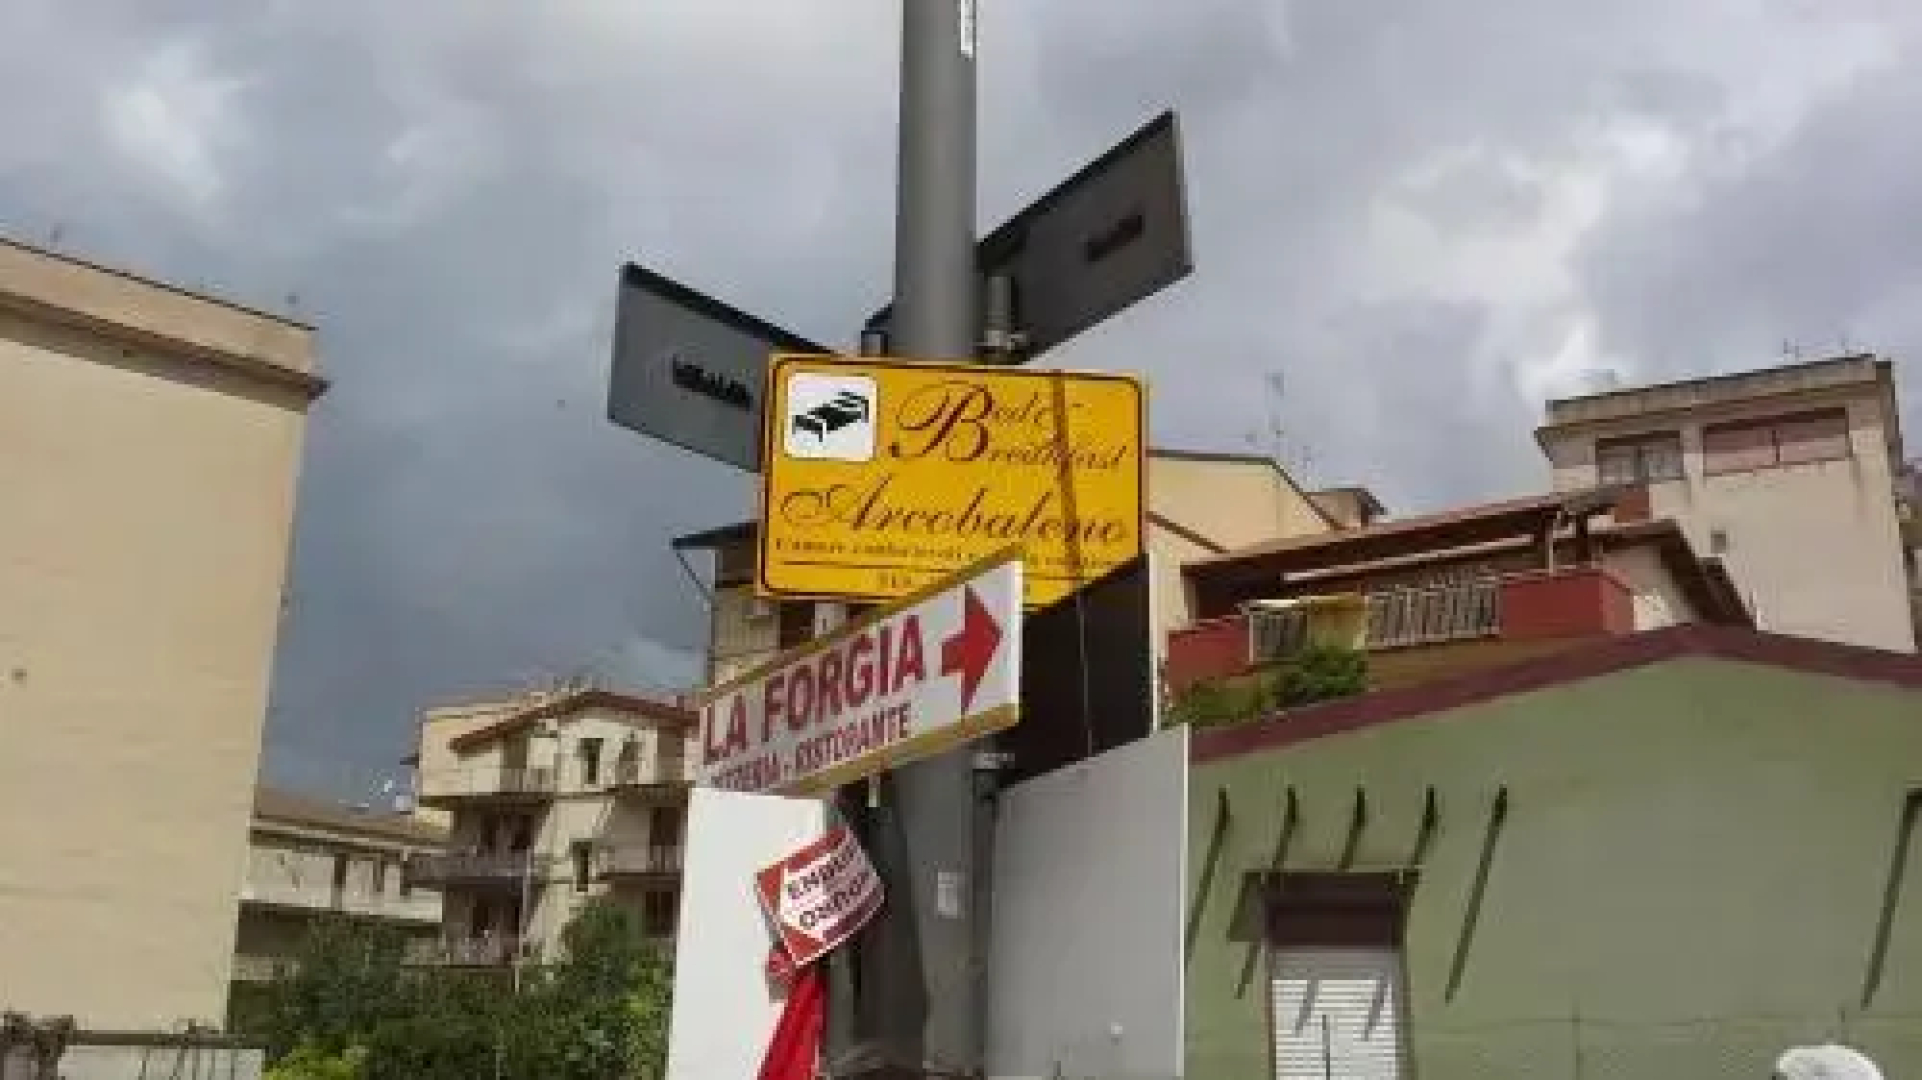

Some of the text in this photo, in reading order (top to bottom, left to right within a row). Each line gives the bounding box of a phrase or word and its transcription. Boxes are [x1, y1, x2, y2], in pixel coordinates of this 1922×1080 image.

[780, 473, 1131, 543] Arcobaleno
[703, 614, 925, 766] LA FORGIA
[795, 702, 912, 770] RISTORANTE
